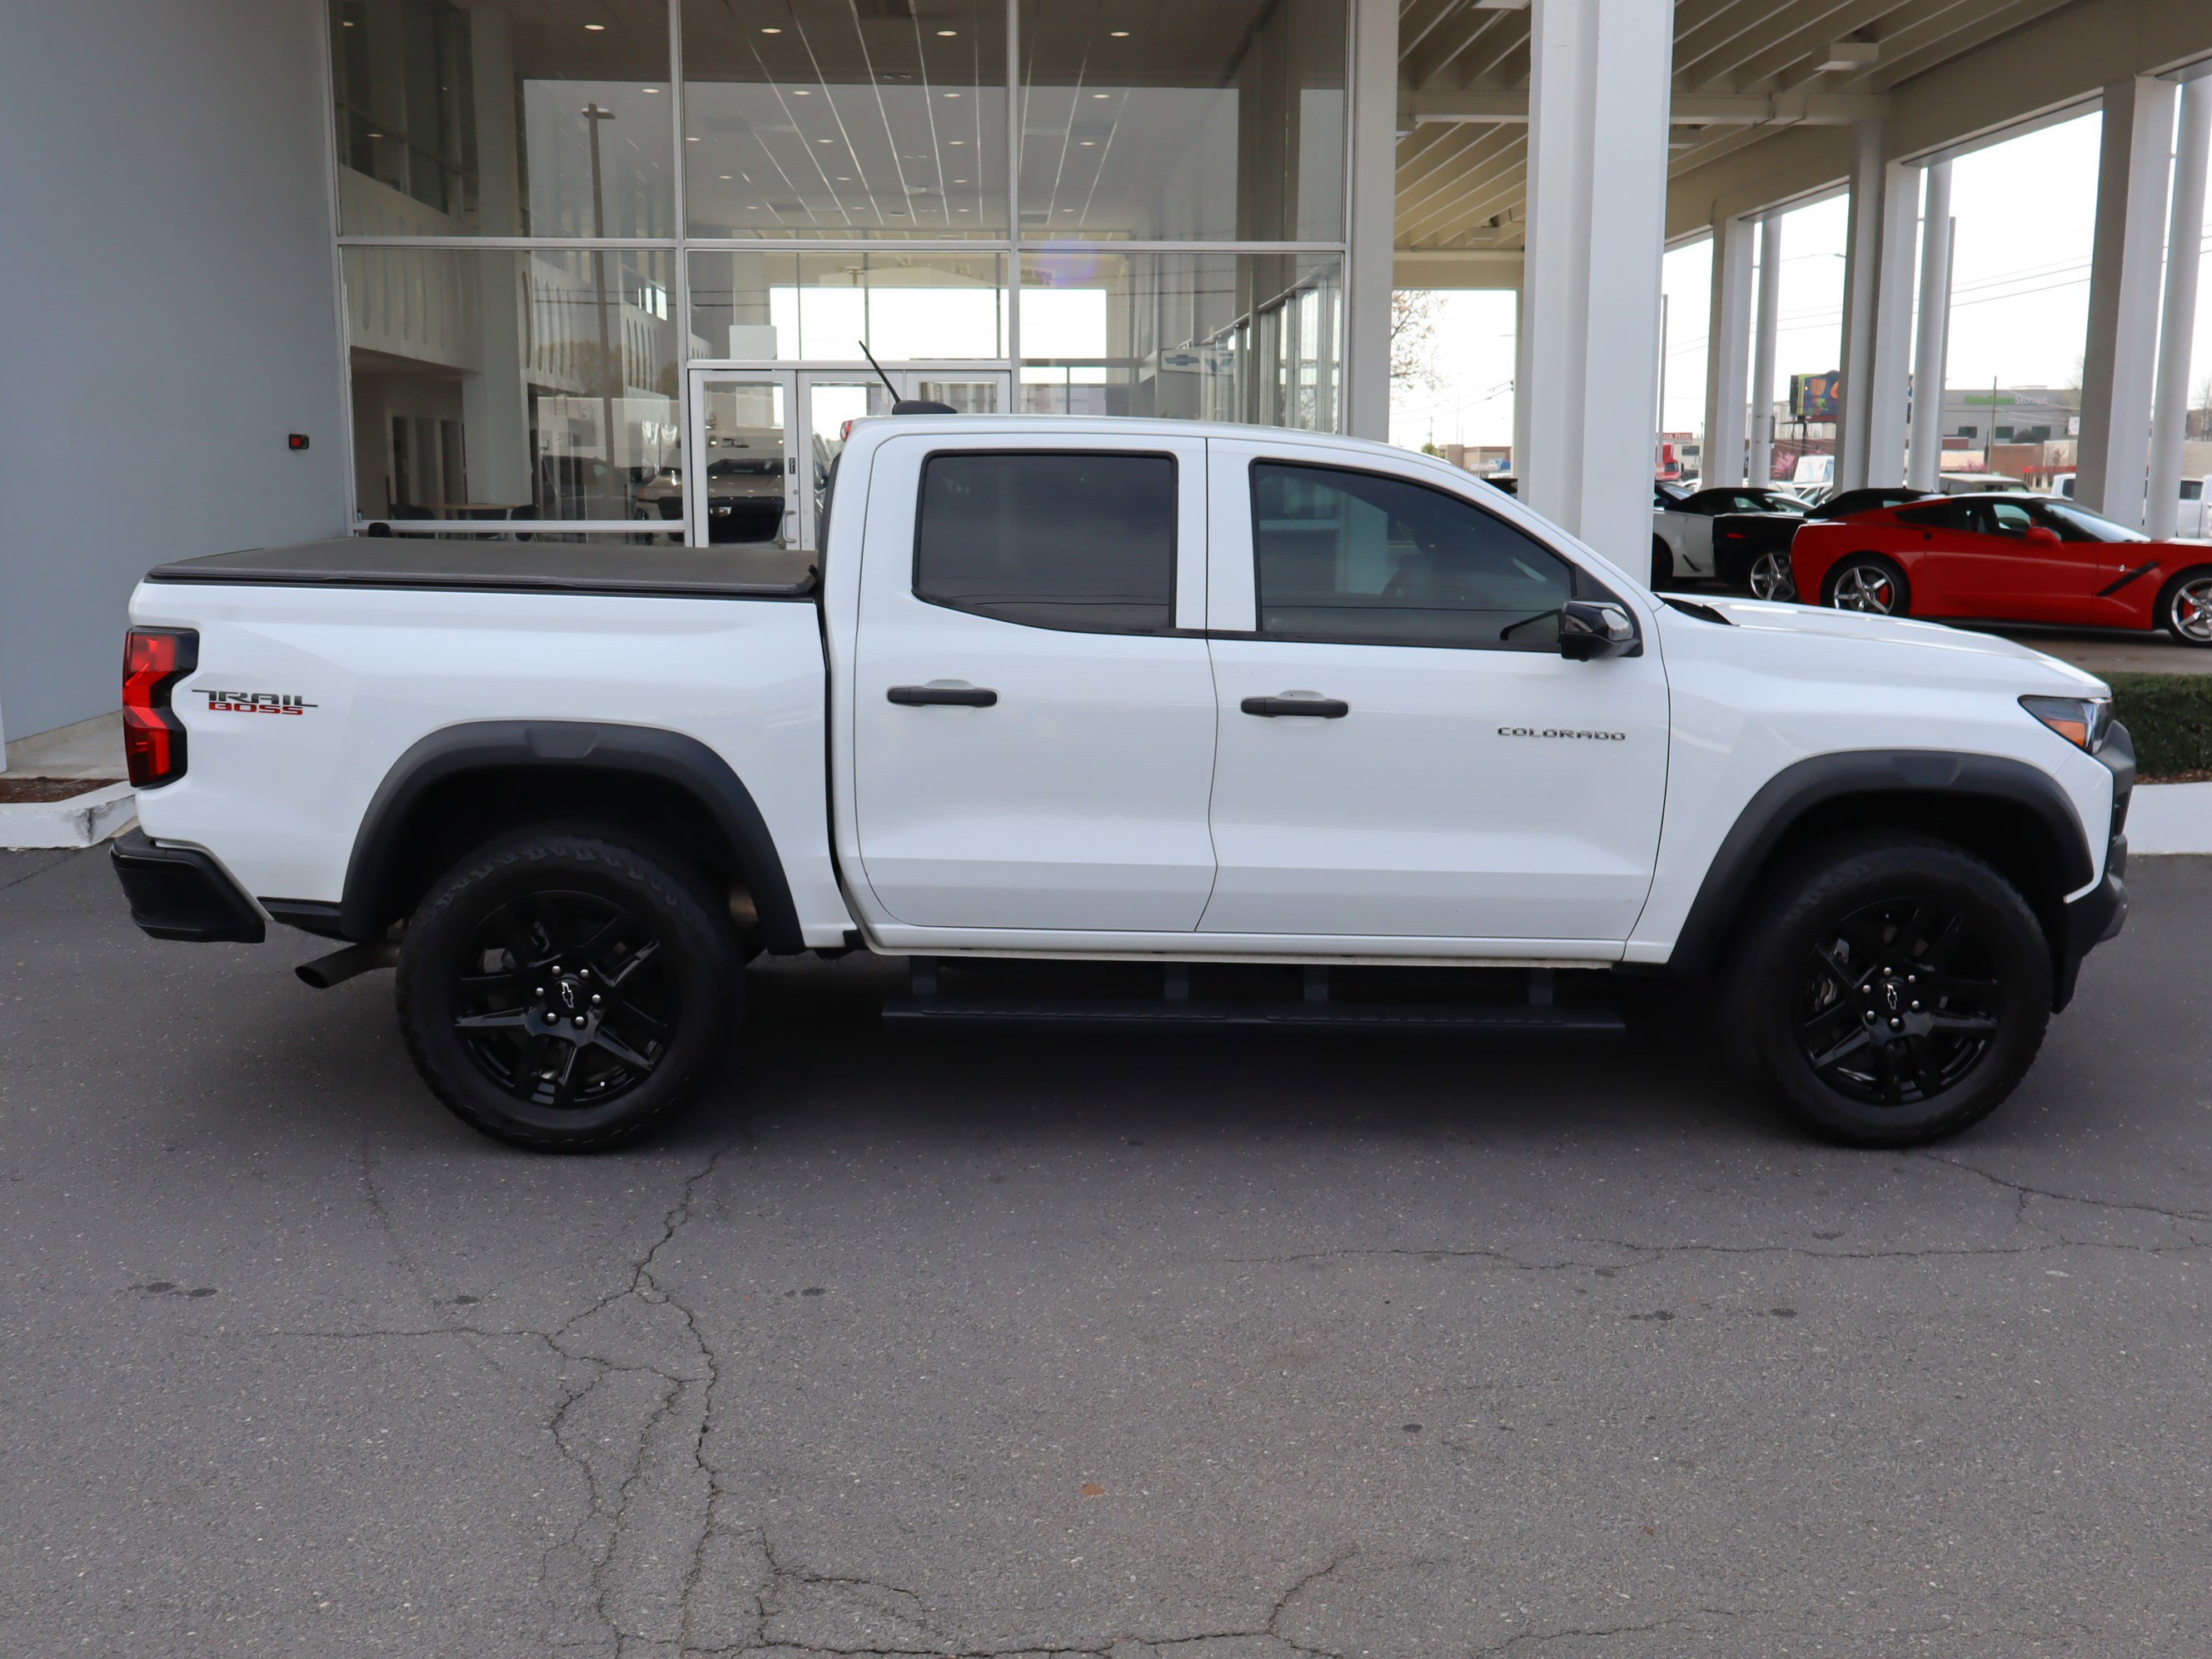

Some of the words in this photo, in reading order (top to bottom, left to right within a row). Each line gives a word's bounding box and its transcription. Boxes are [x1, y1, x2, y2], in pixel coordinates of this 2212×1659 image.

[2015, 394, 2049, 406] Storage
[192, 689, 318, 708] TRAIL
[208, 701, 304, 715] BOSS
[1497, 726, 1627, 741] COLORADO
